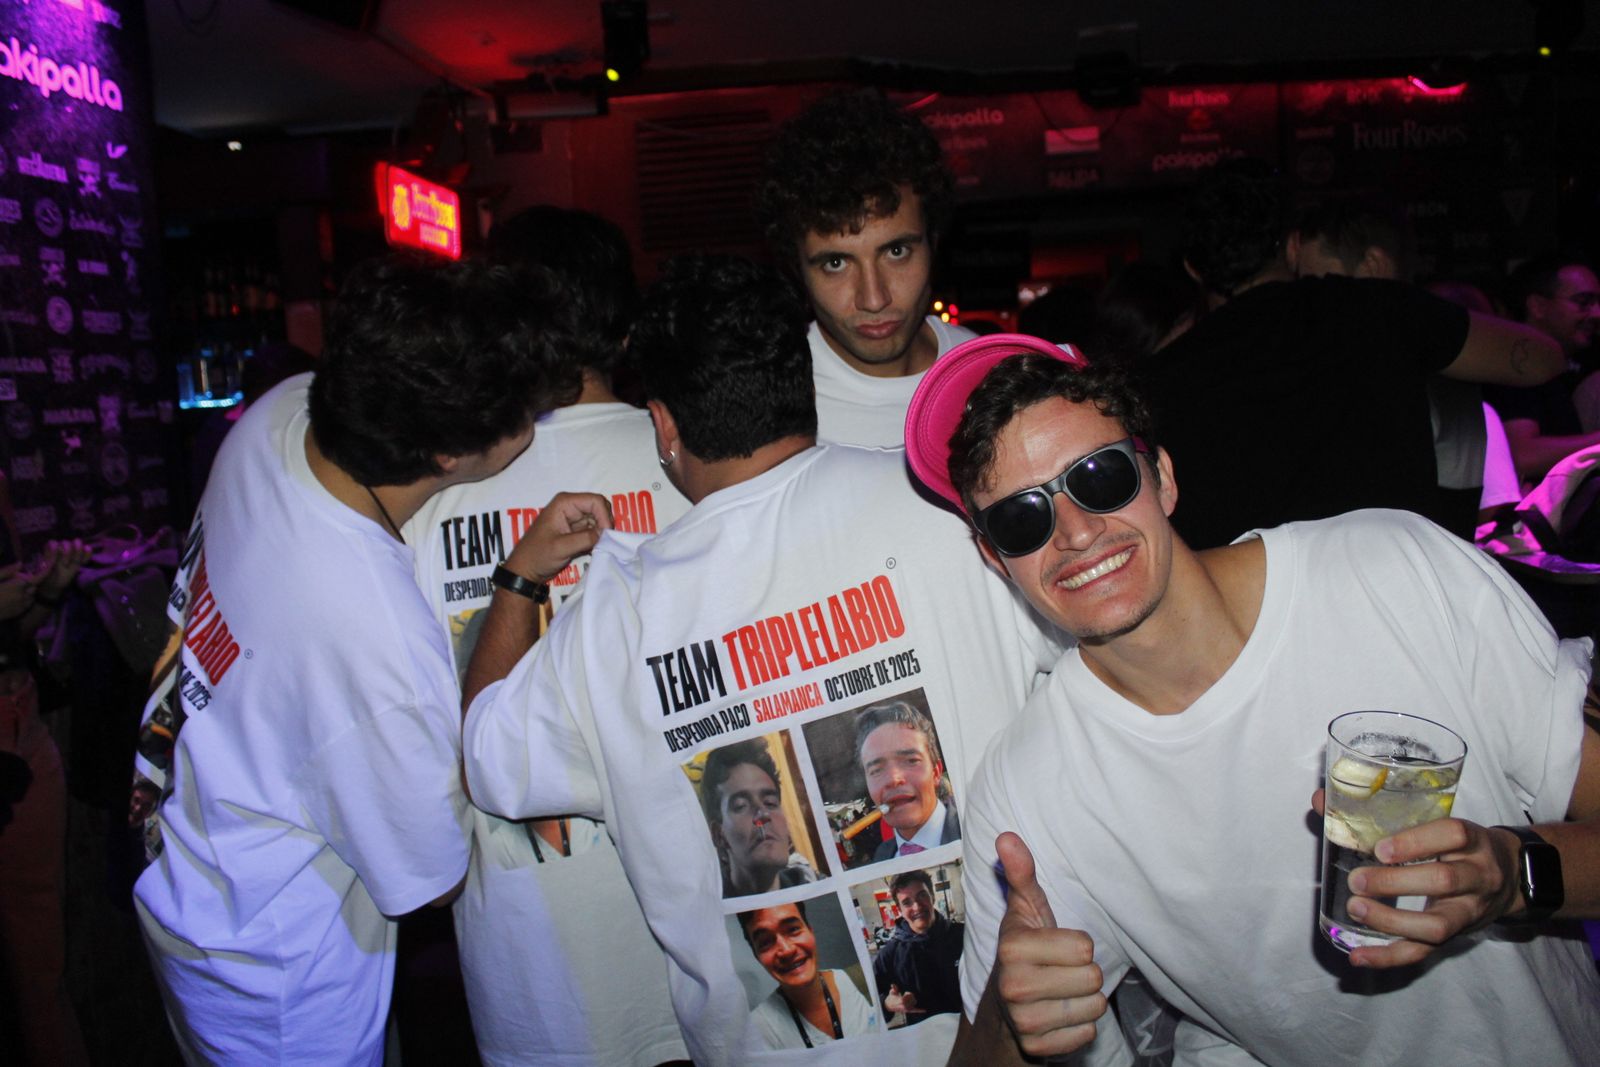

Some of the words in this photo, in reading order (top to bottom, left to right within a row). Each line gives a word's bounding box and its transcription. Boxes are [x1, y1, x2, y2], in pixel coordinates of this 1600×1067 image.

[441, 511, 505, 570] TEAM
[646, 642, 727, 717] TEAM
[722, 575, 905, 690] TRIPLELABIO
[664, 710, 724, 753] DESPEDIDA
[722, 703, 751, 730] PACO
[753, 682, 824, 723] SALAMANCA
[824, 664, 877, 702] OCTUBRE
[874, 659, 892, 684] DE
[889, 649, 921, 680] 2025
